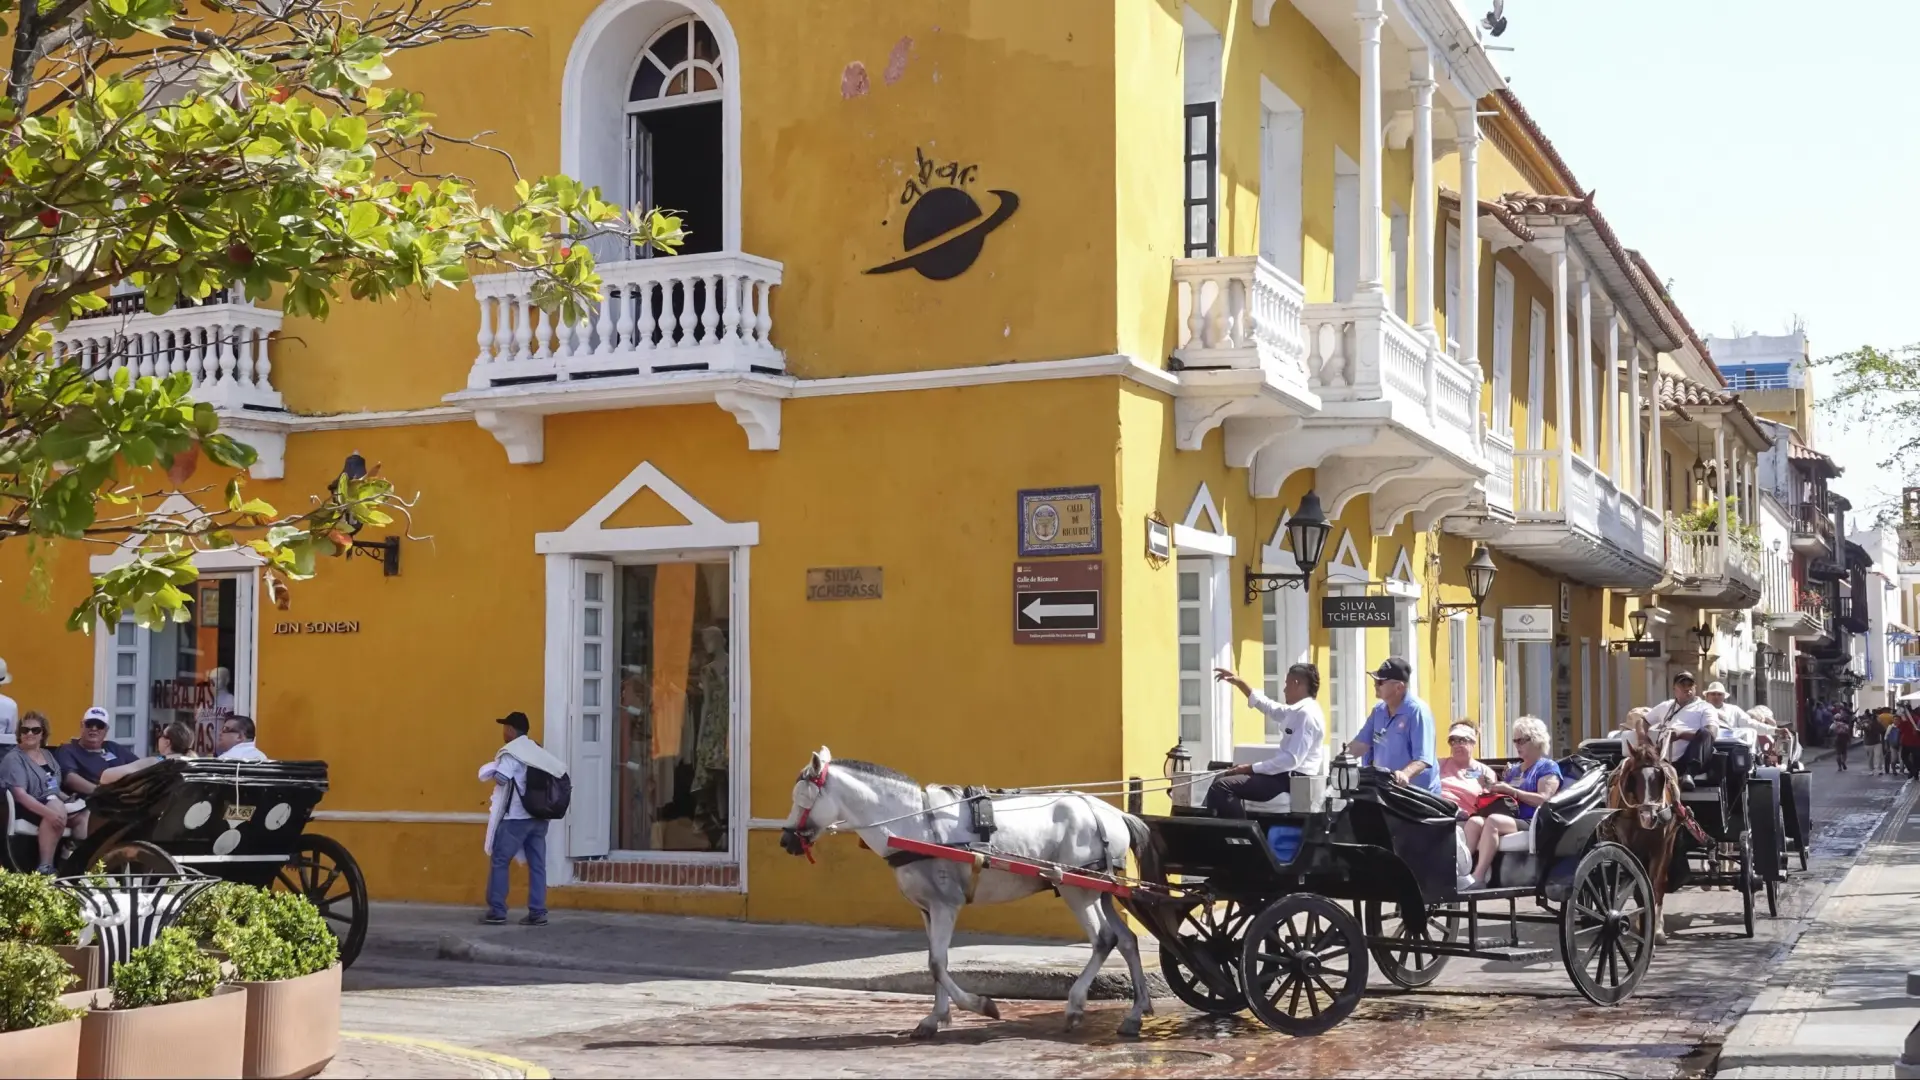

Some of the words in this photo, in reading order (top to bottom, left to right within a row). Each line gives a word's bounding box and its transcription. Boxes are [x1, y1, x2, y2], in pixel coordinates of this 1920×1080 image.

[824, 569, 863, 582] SILVIA
[809, 583, 879, 598] TCHERASSI
[1340, 601, 1377, 611] SILVIA
[1327, 612, 1390, 621] TCHERASSI
[273, 622, 301, 634] JON
[305, 621, 359, 633] SONEN
[153, 679, 215, 709] REBAJAS
